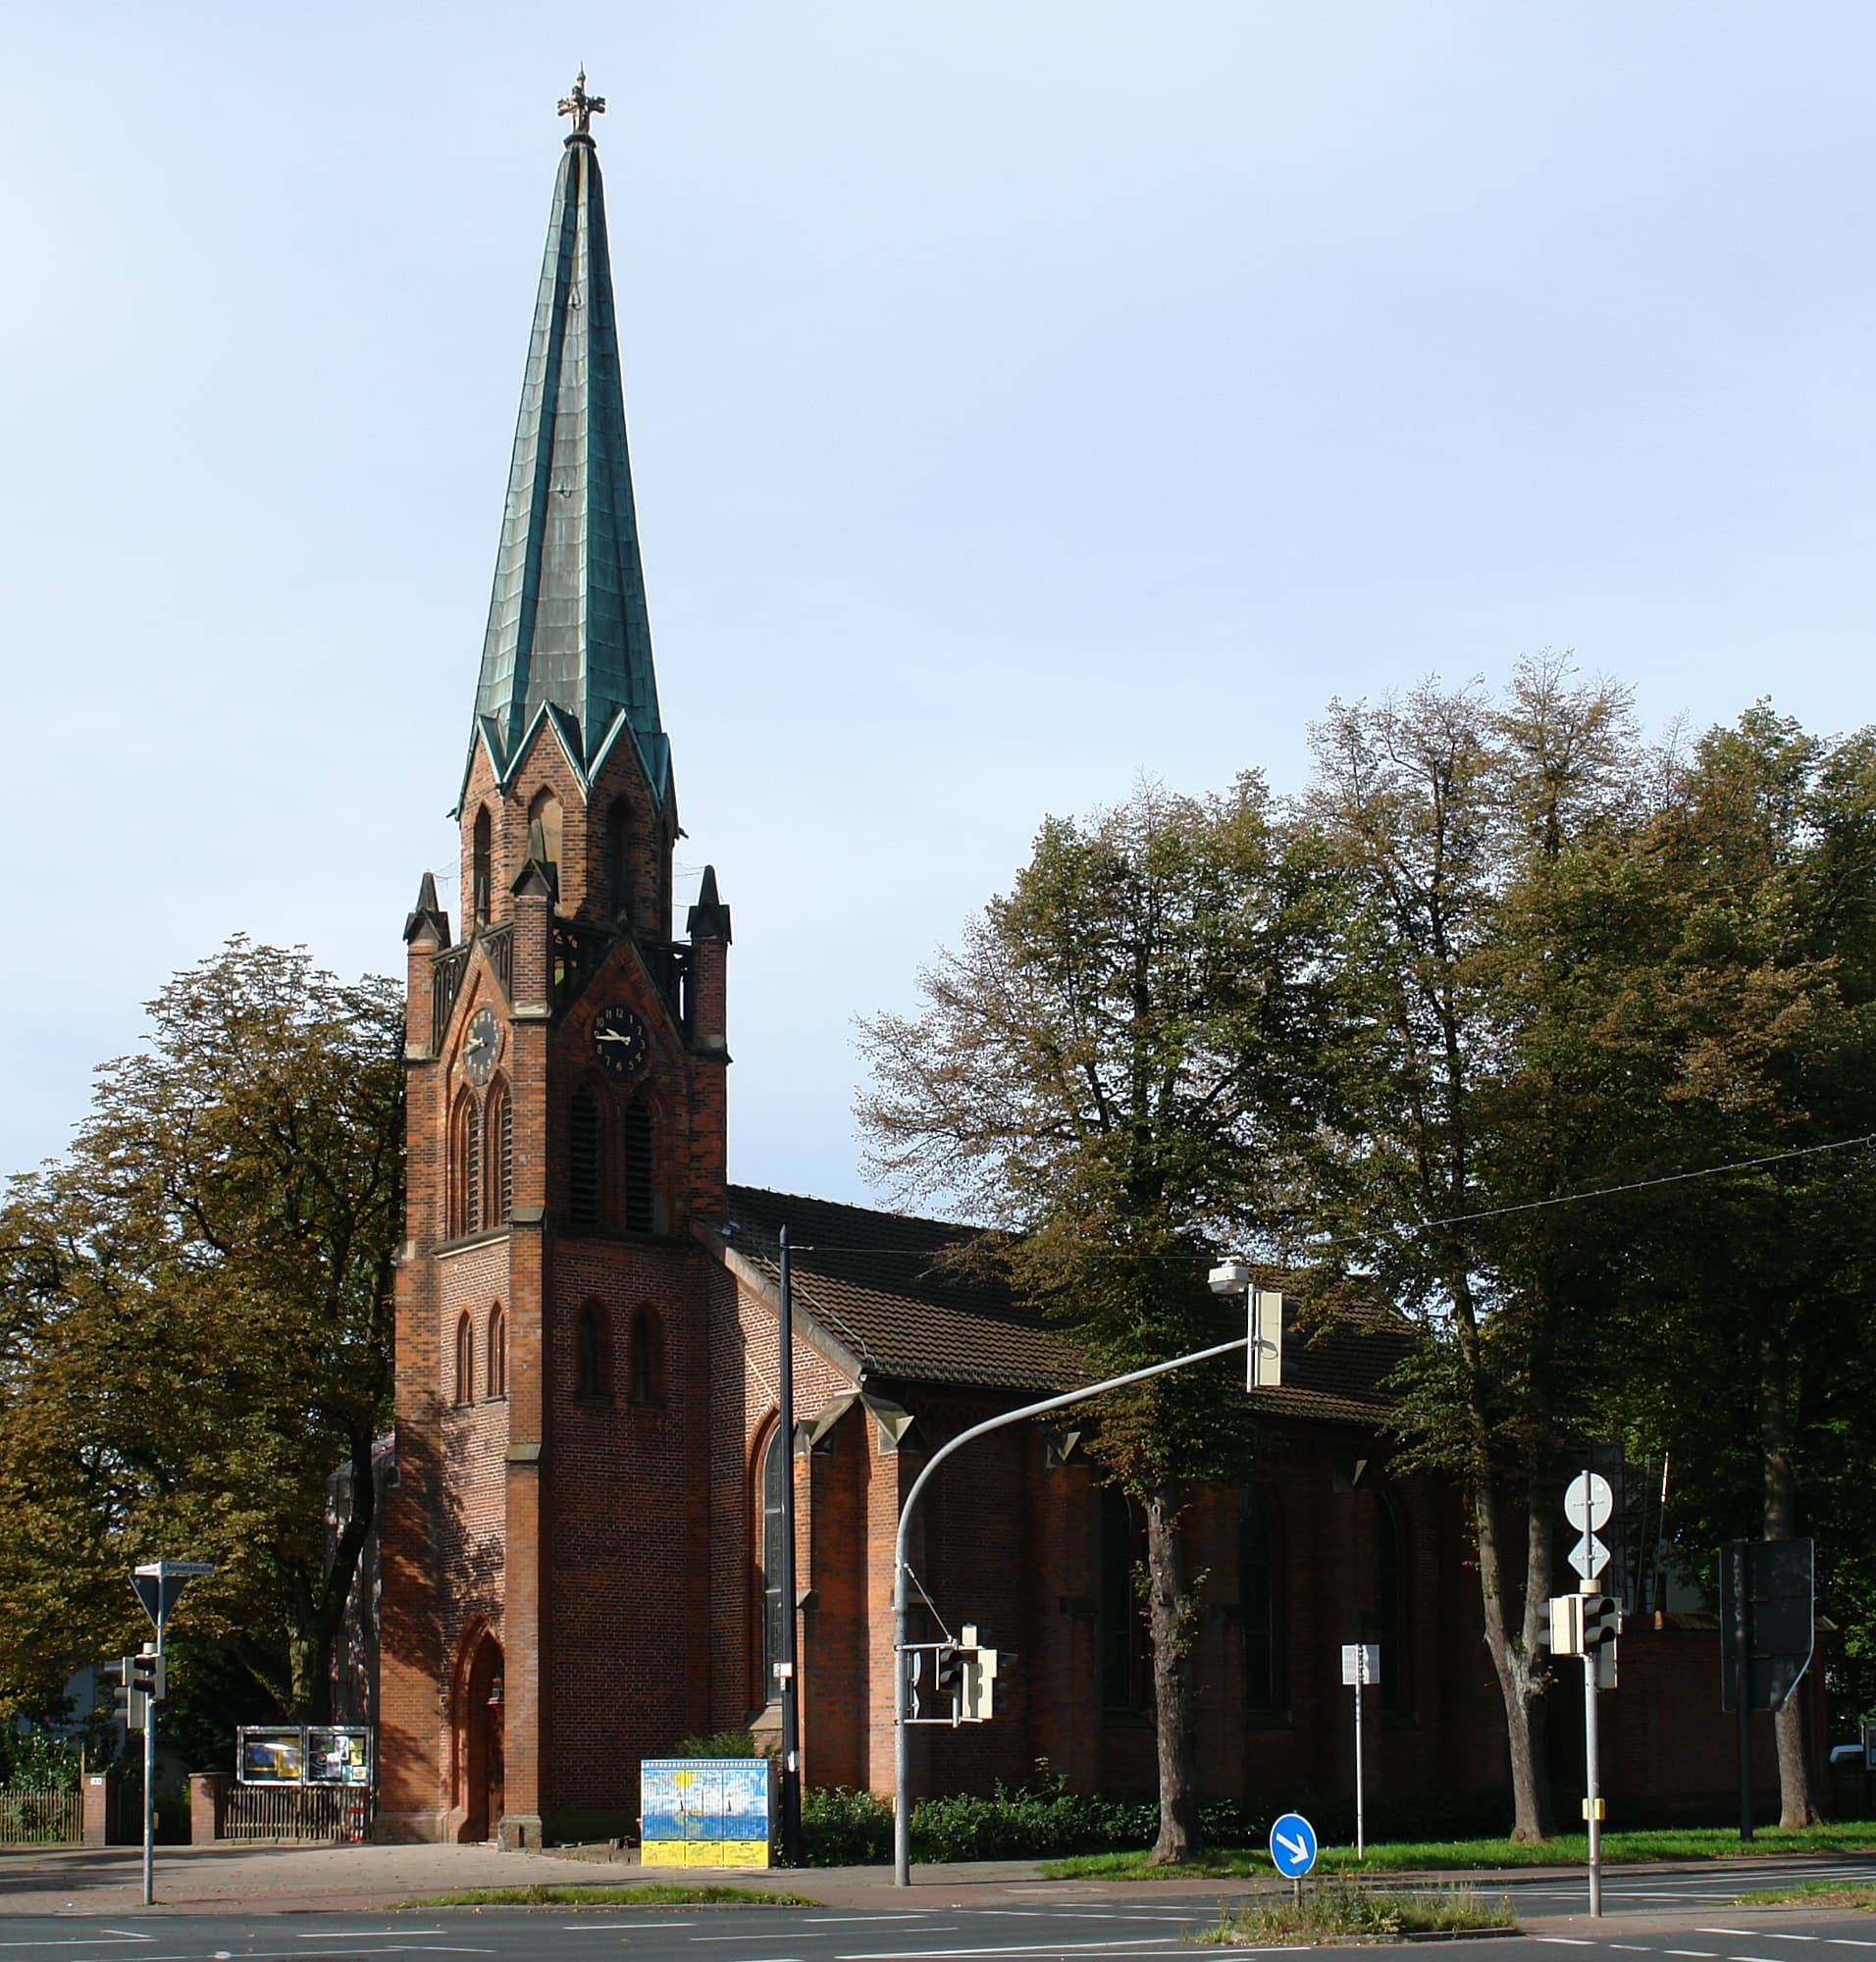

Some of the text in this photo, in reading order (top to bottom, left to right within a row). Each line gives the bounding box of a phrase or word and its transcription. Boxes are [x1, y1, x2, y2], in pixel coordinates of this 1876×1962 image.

[605, 1009, 611, 1019] 11
[616, 1008, 623, 1018] 12
[597, 1018, 604, 1027] 10
[630, 1014, 633, 1024] 1
[638, 1026, 642, 1035] 2
[597, 1045, 602, 1054] 8
[640, 1040, 646, 1050] 3
[605, 1056, 610, 1065] 7
[636, 1053, 642, 1062] 4
[616, 1061, 622, 1071] 6
[628, 1060, 634, 1070] 5
